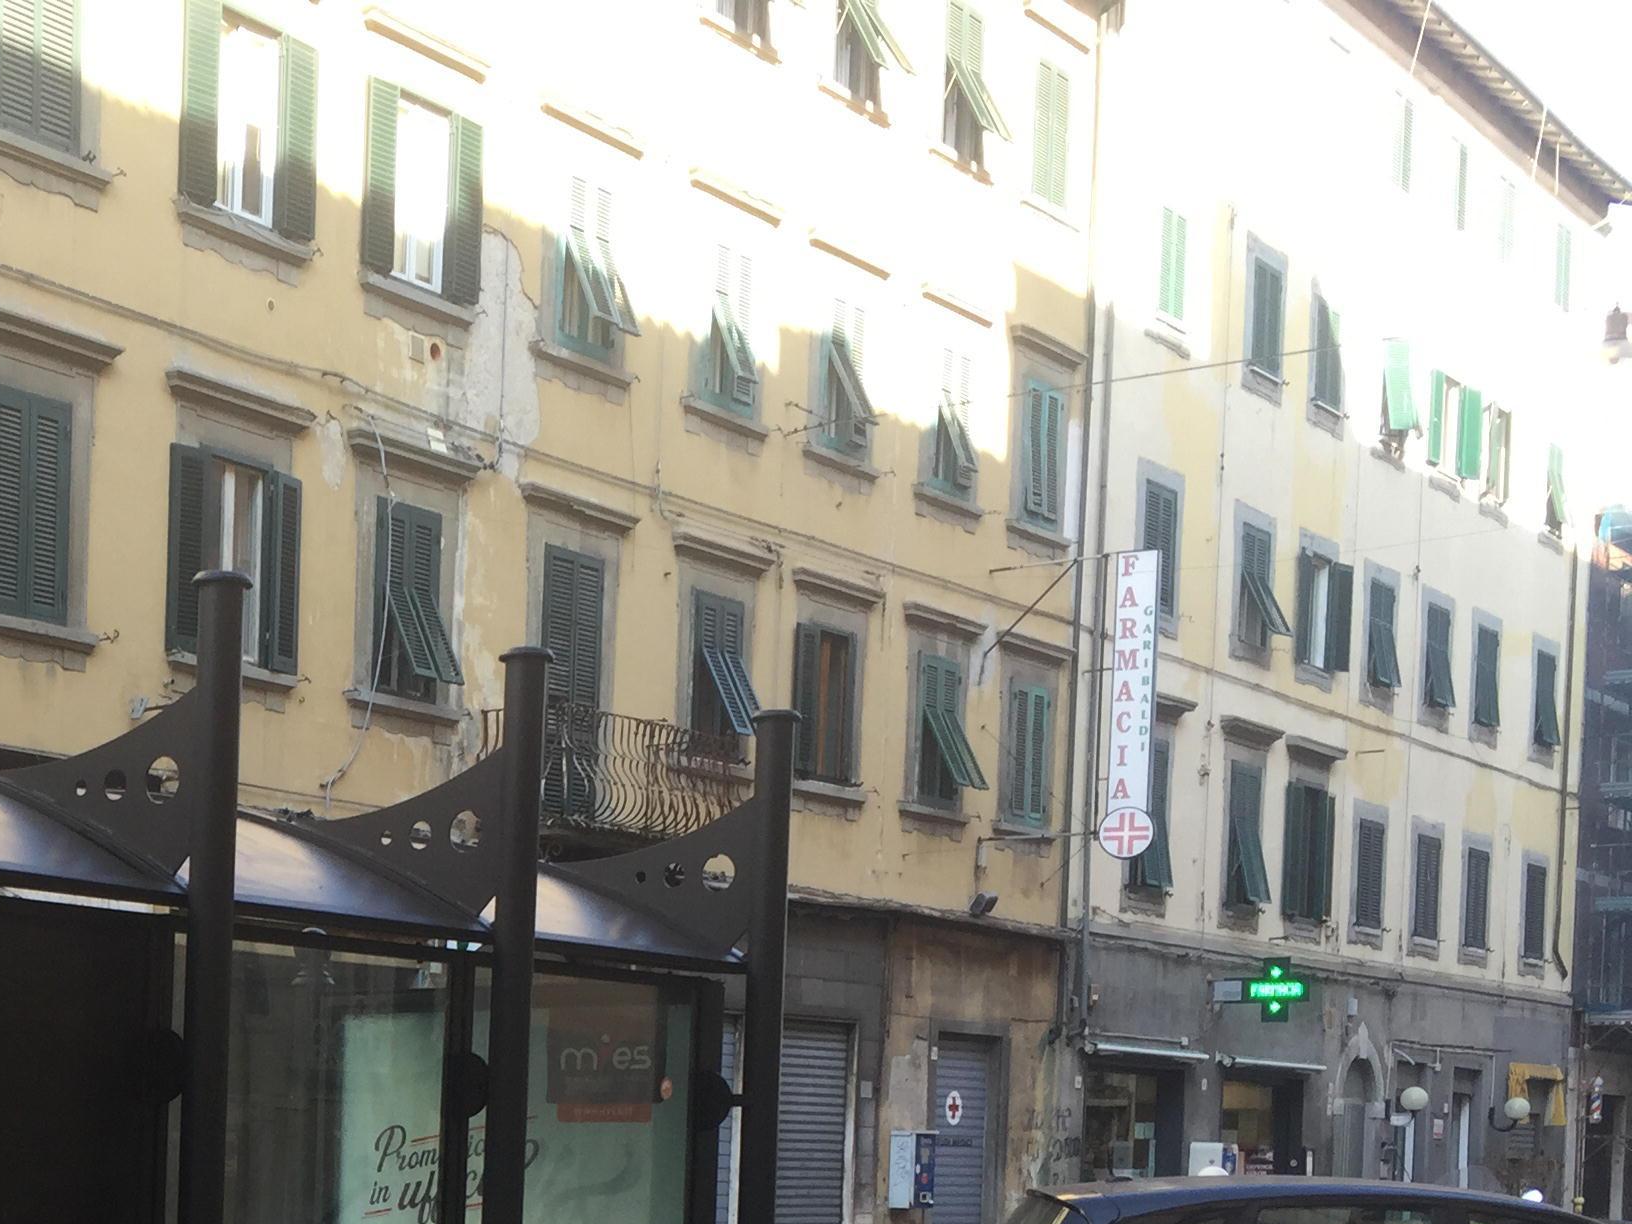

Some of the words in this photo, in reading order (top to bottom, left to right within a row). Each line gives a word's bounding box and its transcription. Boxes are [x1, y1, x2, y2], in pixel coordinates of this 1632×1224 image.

[1111, 554, 1141, 800] FARMACIA
[1139, 605, 1154, 753] GARIBALDI
[369, 1181, 390, 1206] in
